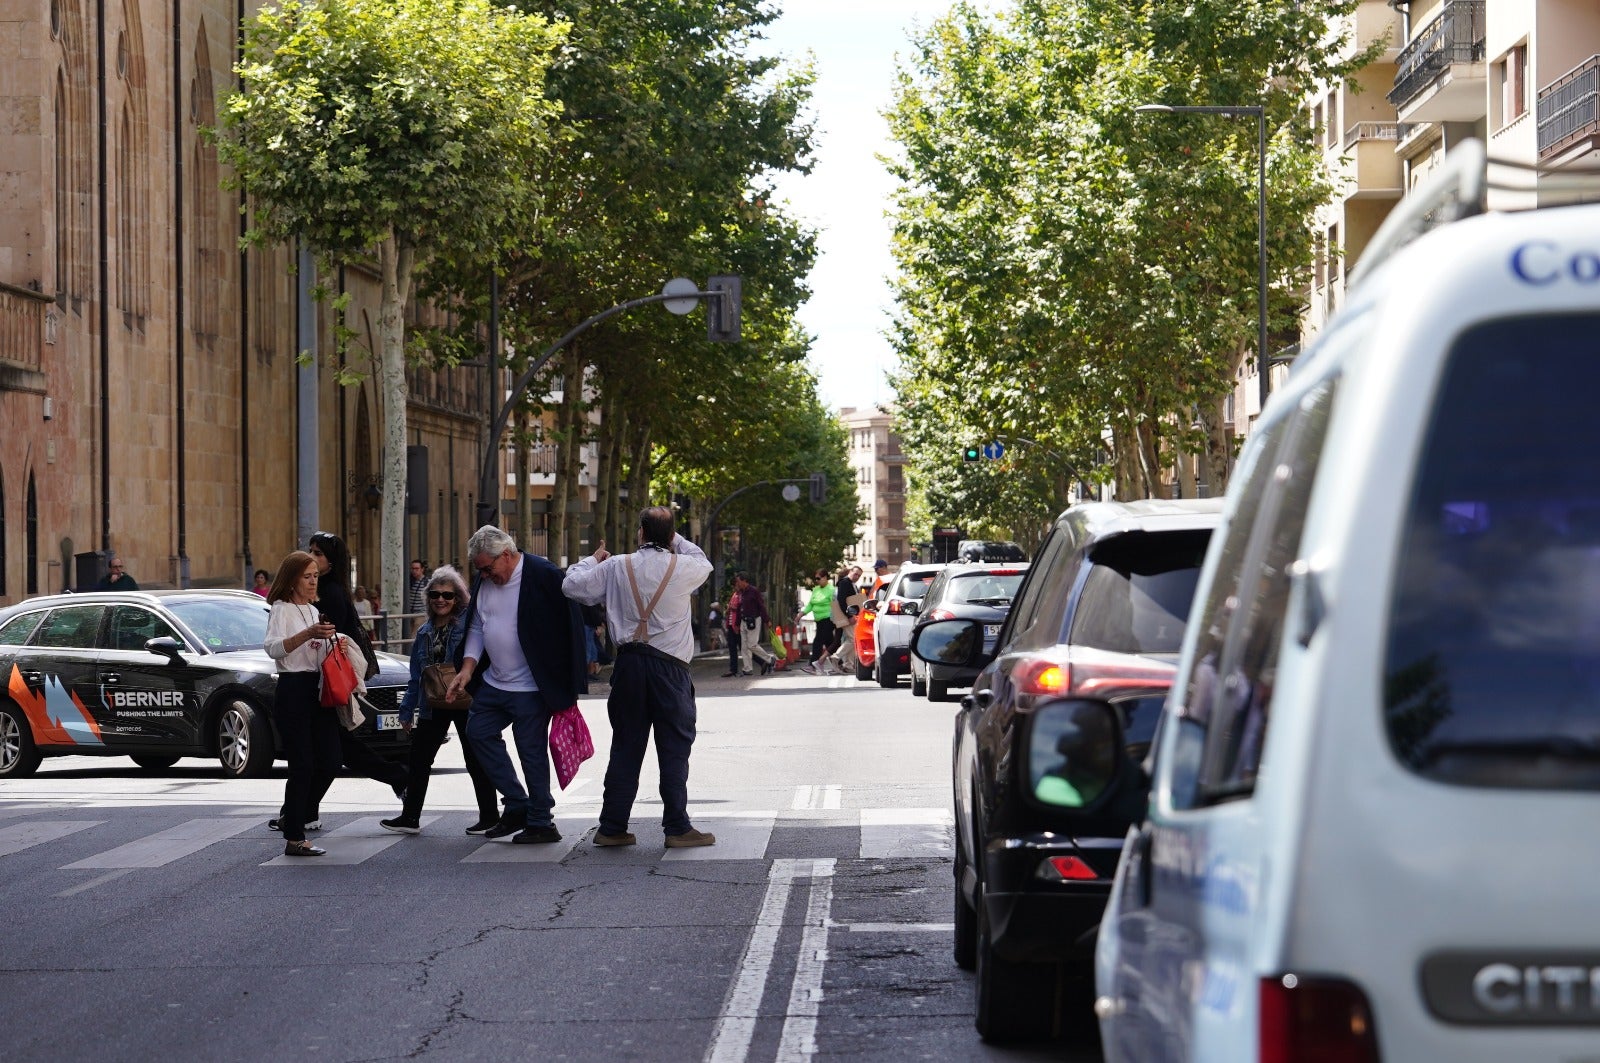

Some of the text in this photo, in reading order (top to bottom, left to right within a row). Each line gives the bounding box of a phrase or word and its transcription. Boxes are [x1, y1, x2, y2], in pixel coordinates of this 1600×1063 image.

[114, 691, 185, 707] BERNER
[384, 716, 402, 728] 433
[1472, 962, 1600, 1013] CIT
